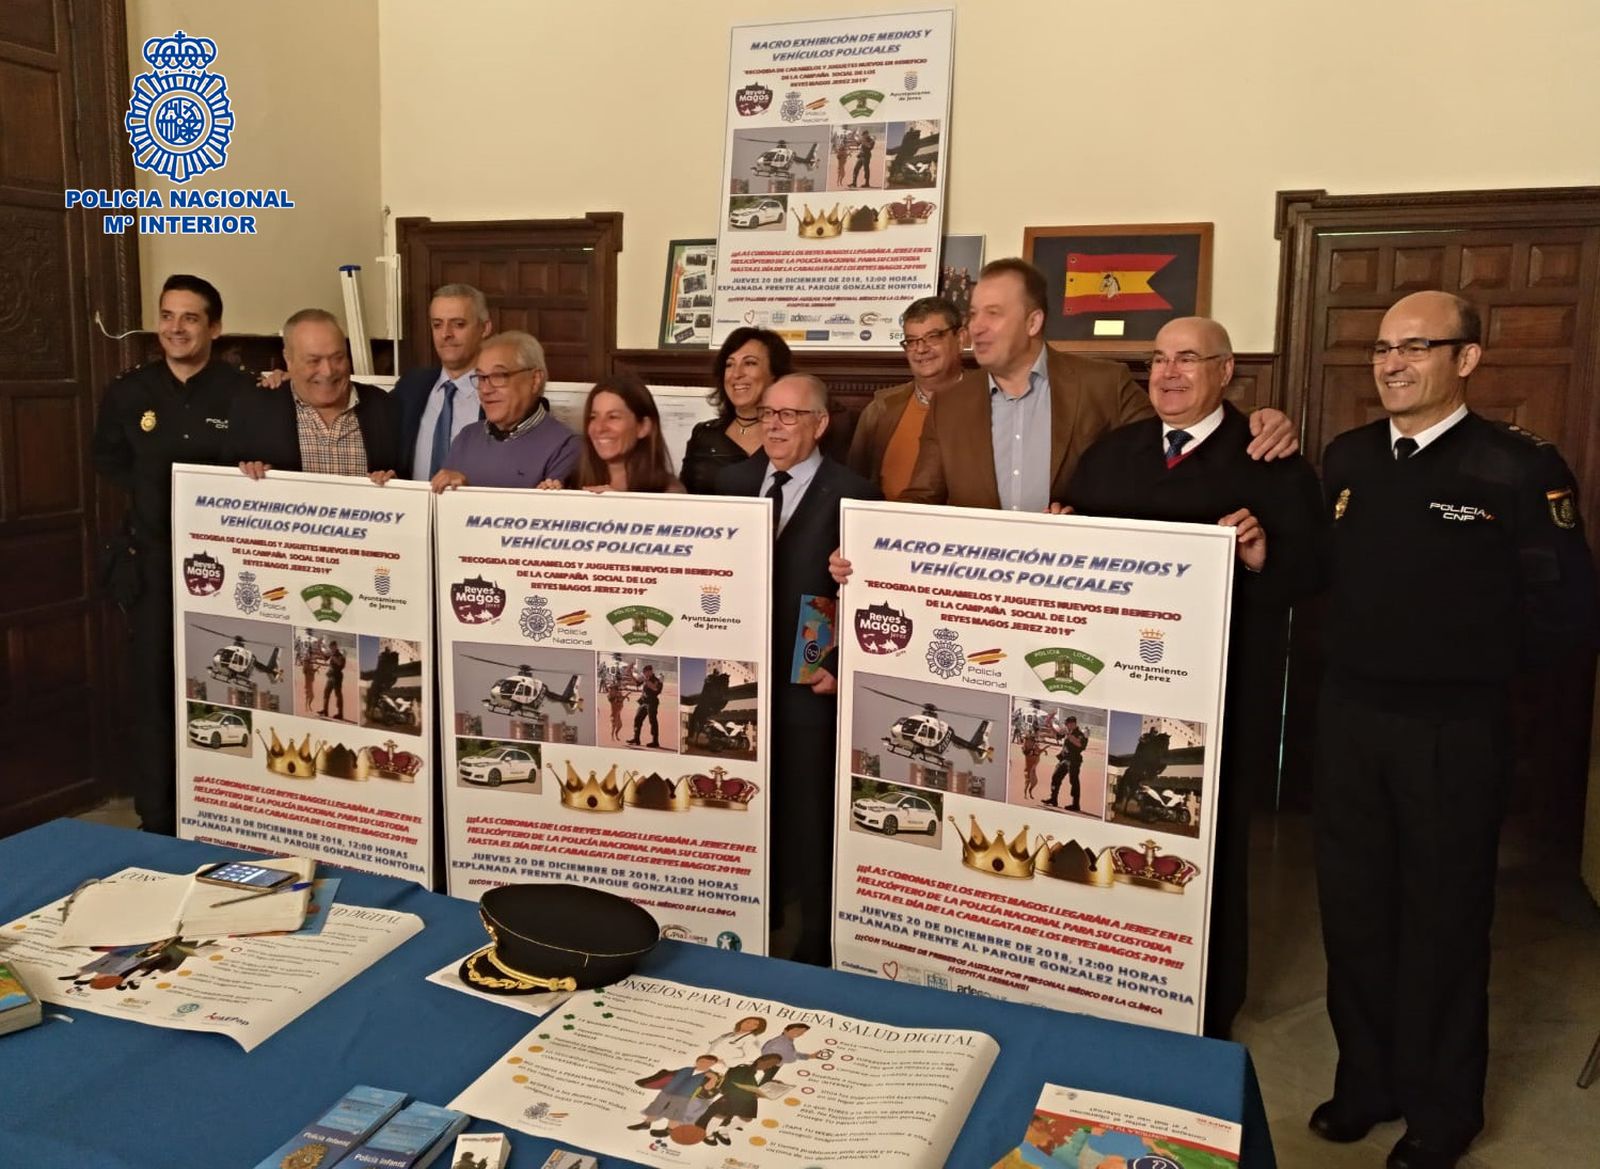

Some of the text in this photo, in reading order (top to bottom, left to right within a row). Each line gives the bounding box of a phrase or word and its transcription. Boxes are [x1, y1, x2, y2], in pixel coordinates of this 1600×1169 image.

[751, 29, 932, 50] MACRO EXHIBICIÓN DE MEDIOS Y
[772, 44, 901, 61] VEHÍCULOS POLICIALES
[196, 496, 405, 524] MACRO EXHIBICIÓN DE MEDIOS Y
[1430, 502, 1486, 517] POLICIA
[1443, 512, 1475, 521] CNP
[221, 515, 367, 539] VEHÍCULOS POLICIALES
[466, 516, 739, 540] MACRO EXHIBICIÓN DE MEDIOS Y
[501, 535, 693, 557] VEHÍCULOS POLICIALES
[874, 537, 1192, 578] MACRO EXHIBICIÓN DE MEDIOS Y
[911, 561, 1134, 595] VEHÍCULOS POLICIALES
[456, 592, 500, 604] Magos
[465, 586, 494, 595] Reyes
[918, 585, 930, 594] DE
[932, 587, 992, 601] CARAMELOS
[994, 593, 1001, 602] Y
[1002, 594, 1056, 608] JUGUETES
[1057, 600, 1102, 613] NUEVOS
[1104, 604, 1119, 615] EN
[1122, 606, 1181, 622] BENEFICIO
[940, 601, 953, 609] LA
[955, 603, 1006, 615] CAMPAÑA
[1011, 609, 1048, 620] SOCIAL
[1050, 613, 1064, 622] DE
[1067, 615, 1087, 625] LOS
[681, 614, 741, 624] Ayuntamiento
[860, 619, 906, 634] Magos
[870, 612, 900, 624] Reyes
[941, 614, 970, 624] REYES
[972, 617, 1009, 628] MAGOS
[1010, 622, 1042, 633] JEREZ
[1114, 661, 1188, 676] Ayuntamiento
[1144, 673, 1171, 682] Jerez
[962, 676, 1007, 688] Nacional
[182, 817, 425, 874] EXPLANADA FRENTE AL PARQUE GONZALEZ HONTORIA
[198, 810, 227, 823] JUEVES
[243, 819, 254, 828] DE
[257, 822, 304, 838] DICIEMBRE
[307, 832, 318, 841] DE
[376, 846, 408, 859] HORAS
[452, 861, 760, 905] EXPLANADA FRENTE AL PARQUE GONZALEZ HONTORIA
[472, 853, 511, 864] JUEVES
[515, 858, 527, 866] 20
[531, 859, 544, 868] DE
[549, 862, 607, 875] DICIEMBRE
[611, 869, 627, 878] DE
[665, 875, 694, 886] 12:00
[698, 879, 738, 891] HORAS
[857, 876, 1172, 954] HELICÓPTERO DE LA POLICÍA NACIONAL PARA SU CUSTODIA
[888, 871, 936, 888] CORONAS
[937, 882, 952, 892] DE
[954, 885, 974, 897] LOS
[975, 890, 1007, 904] REYES
[1008, 897, 1049, 913] MAGOS
[1049, 906, 1111, 926] LLEGARÁN
[1112, 919, 1120, 928] A
[1121, 921, 1160, 937] JEREZ
[1160, 930, 1178, 941] EN
[1179, 934, 1194, 944] EL
[857, 888, 890, 902] HASTA
[892, 896, 904, 905] EL
[905, 899, 924, 910] DÍA
[925, 903, 939, 913] DE
[941, 907, 954, 917] LA
[956, 910, 1021, 932] CABALGATA
[1022, 925, 1039, 936] DE
[1040, 929, 1061, 941] LOS
[1062, 934, 1097, 950] REYES
[1098, 942, 1140, 960] MAGOS
[861, 905, 902, 922] JUEVES
[907, 916, 920, 927] 20
[925, 920, 940, 931] DE
[945, 925, 1011, 948] DICIEMBRE
[1016, 942, 1032, 953] DE
[1079, 957, 1113, 973] 12:00
[1118, 966, 1168, 986] HORAS
[839, 911, 1194, 1006] EXPLANADA FRENTE AL PARQUE GONZALEZ HONTORIA
[616, 980, 684, 998] ONSEJOS
[688, 991, 730, 1007] PARA
[736, 1000, 770, 1014] UNA
[776, 1007, 834, 1028] BUENA
[839, 1021, 899, 1041] SALUD
[904, 1032, 976, 1048] DIGITAL
